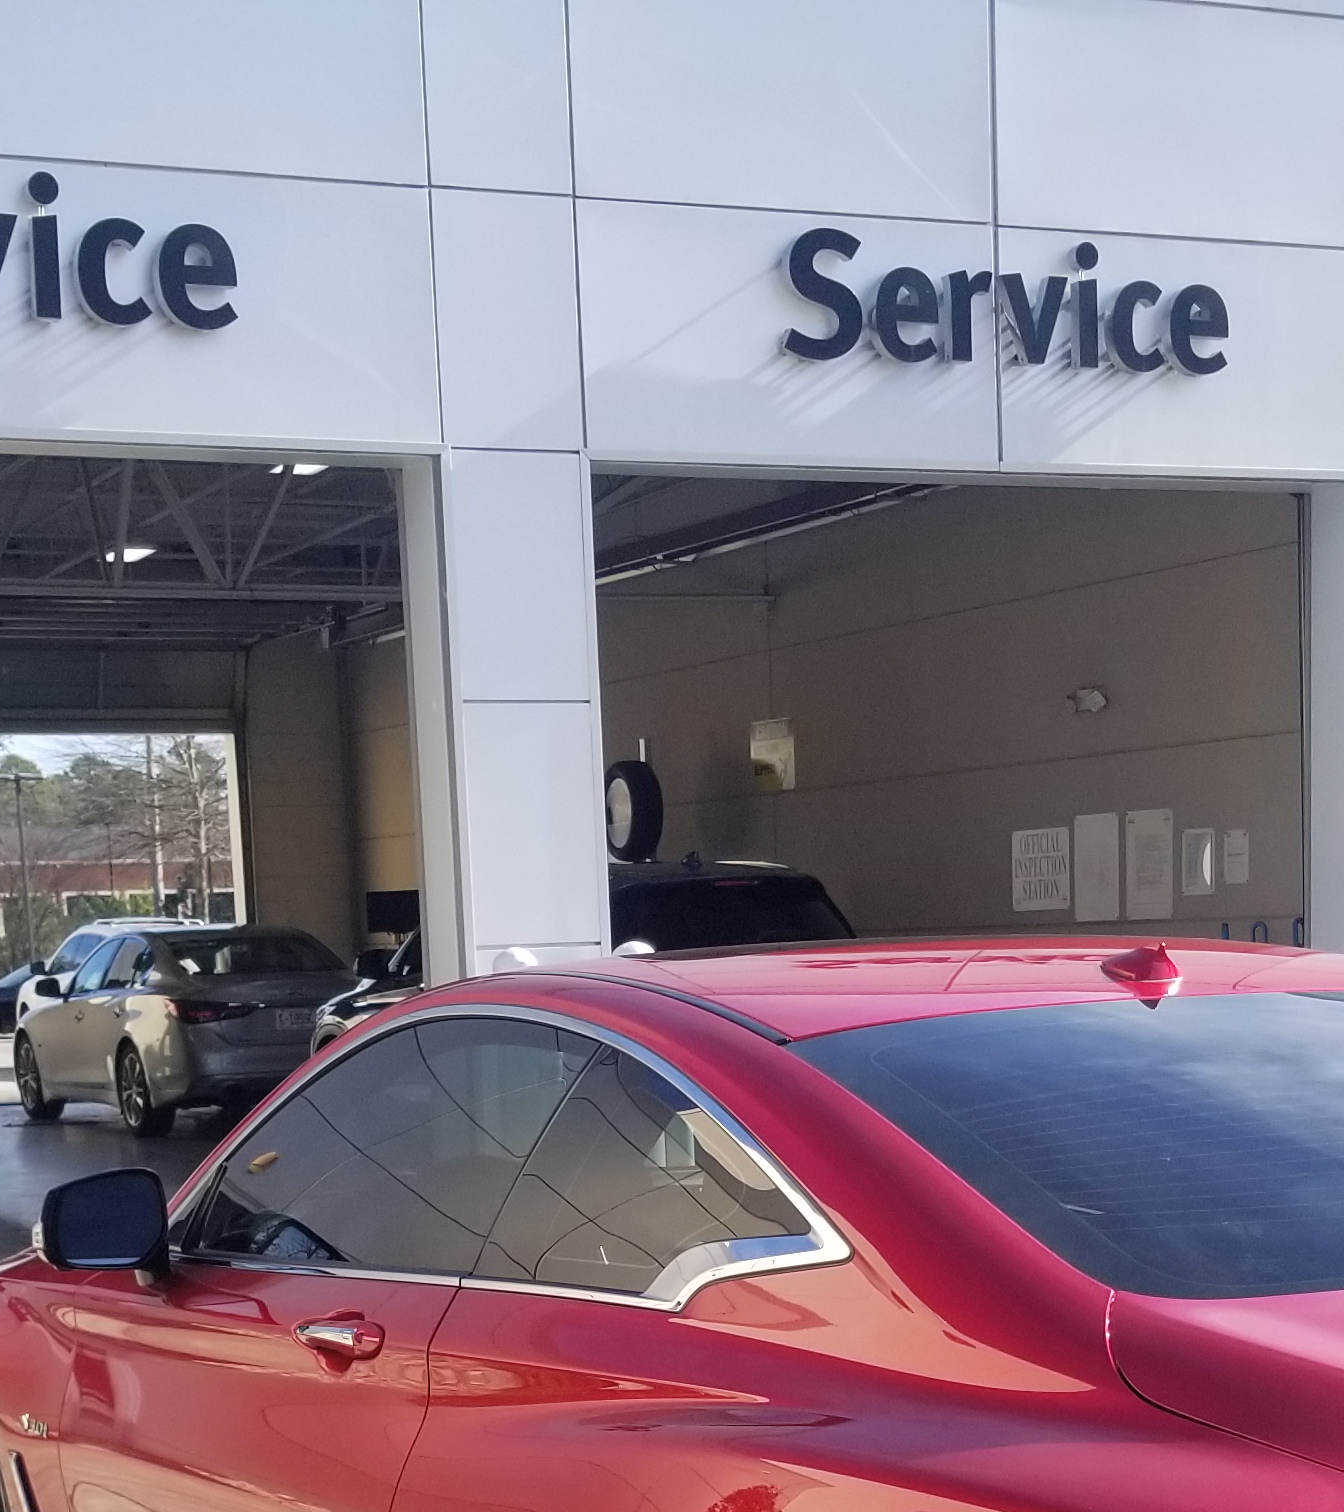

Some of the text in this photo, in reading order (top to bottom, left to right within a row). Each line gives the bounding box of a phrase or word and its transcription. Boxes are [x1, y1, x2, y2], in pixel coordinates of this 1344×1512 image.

[782, 228, 1230, 375] Service
[1019, 831, 1062, 855] OFFICIAL
[1015, 855, 1067, 878] INSPECTION
[1022, 879, 1060, 900] STATION
